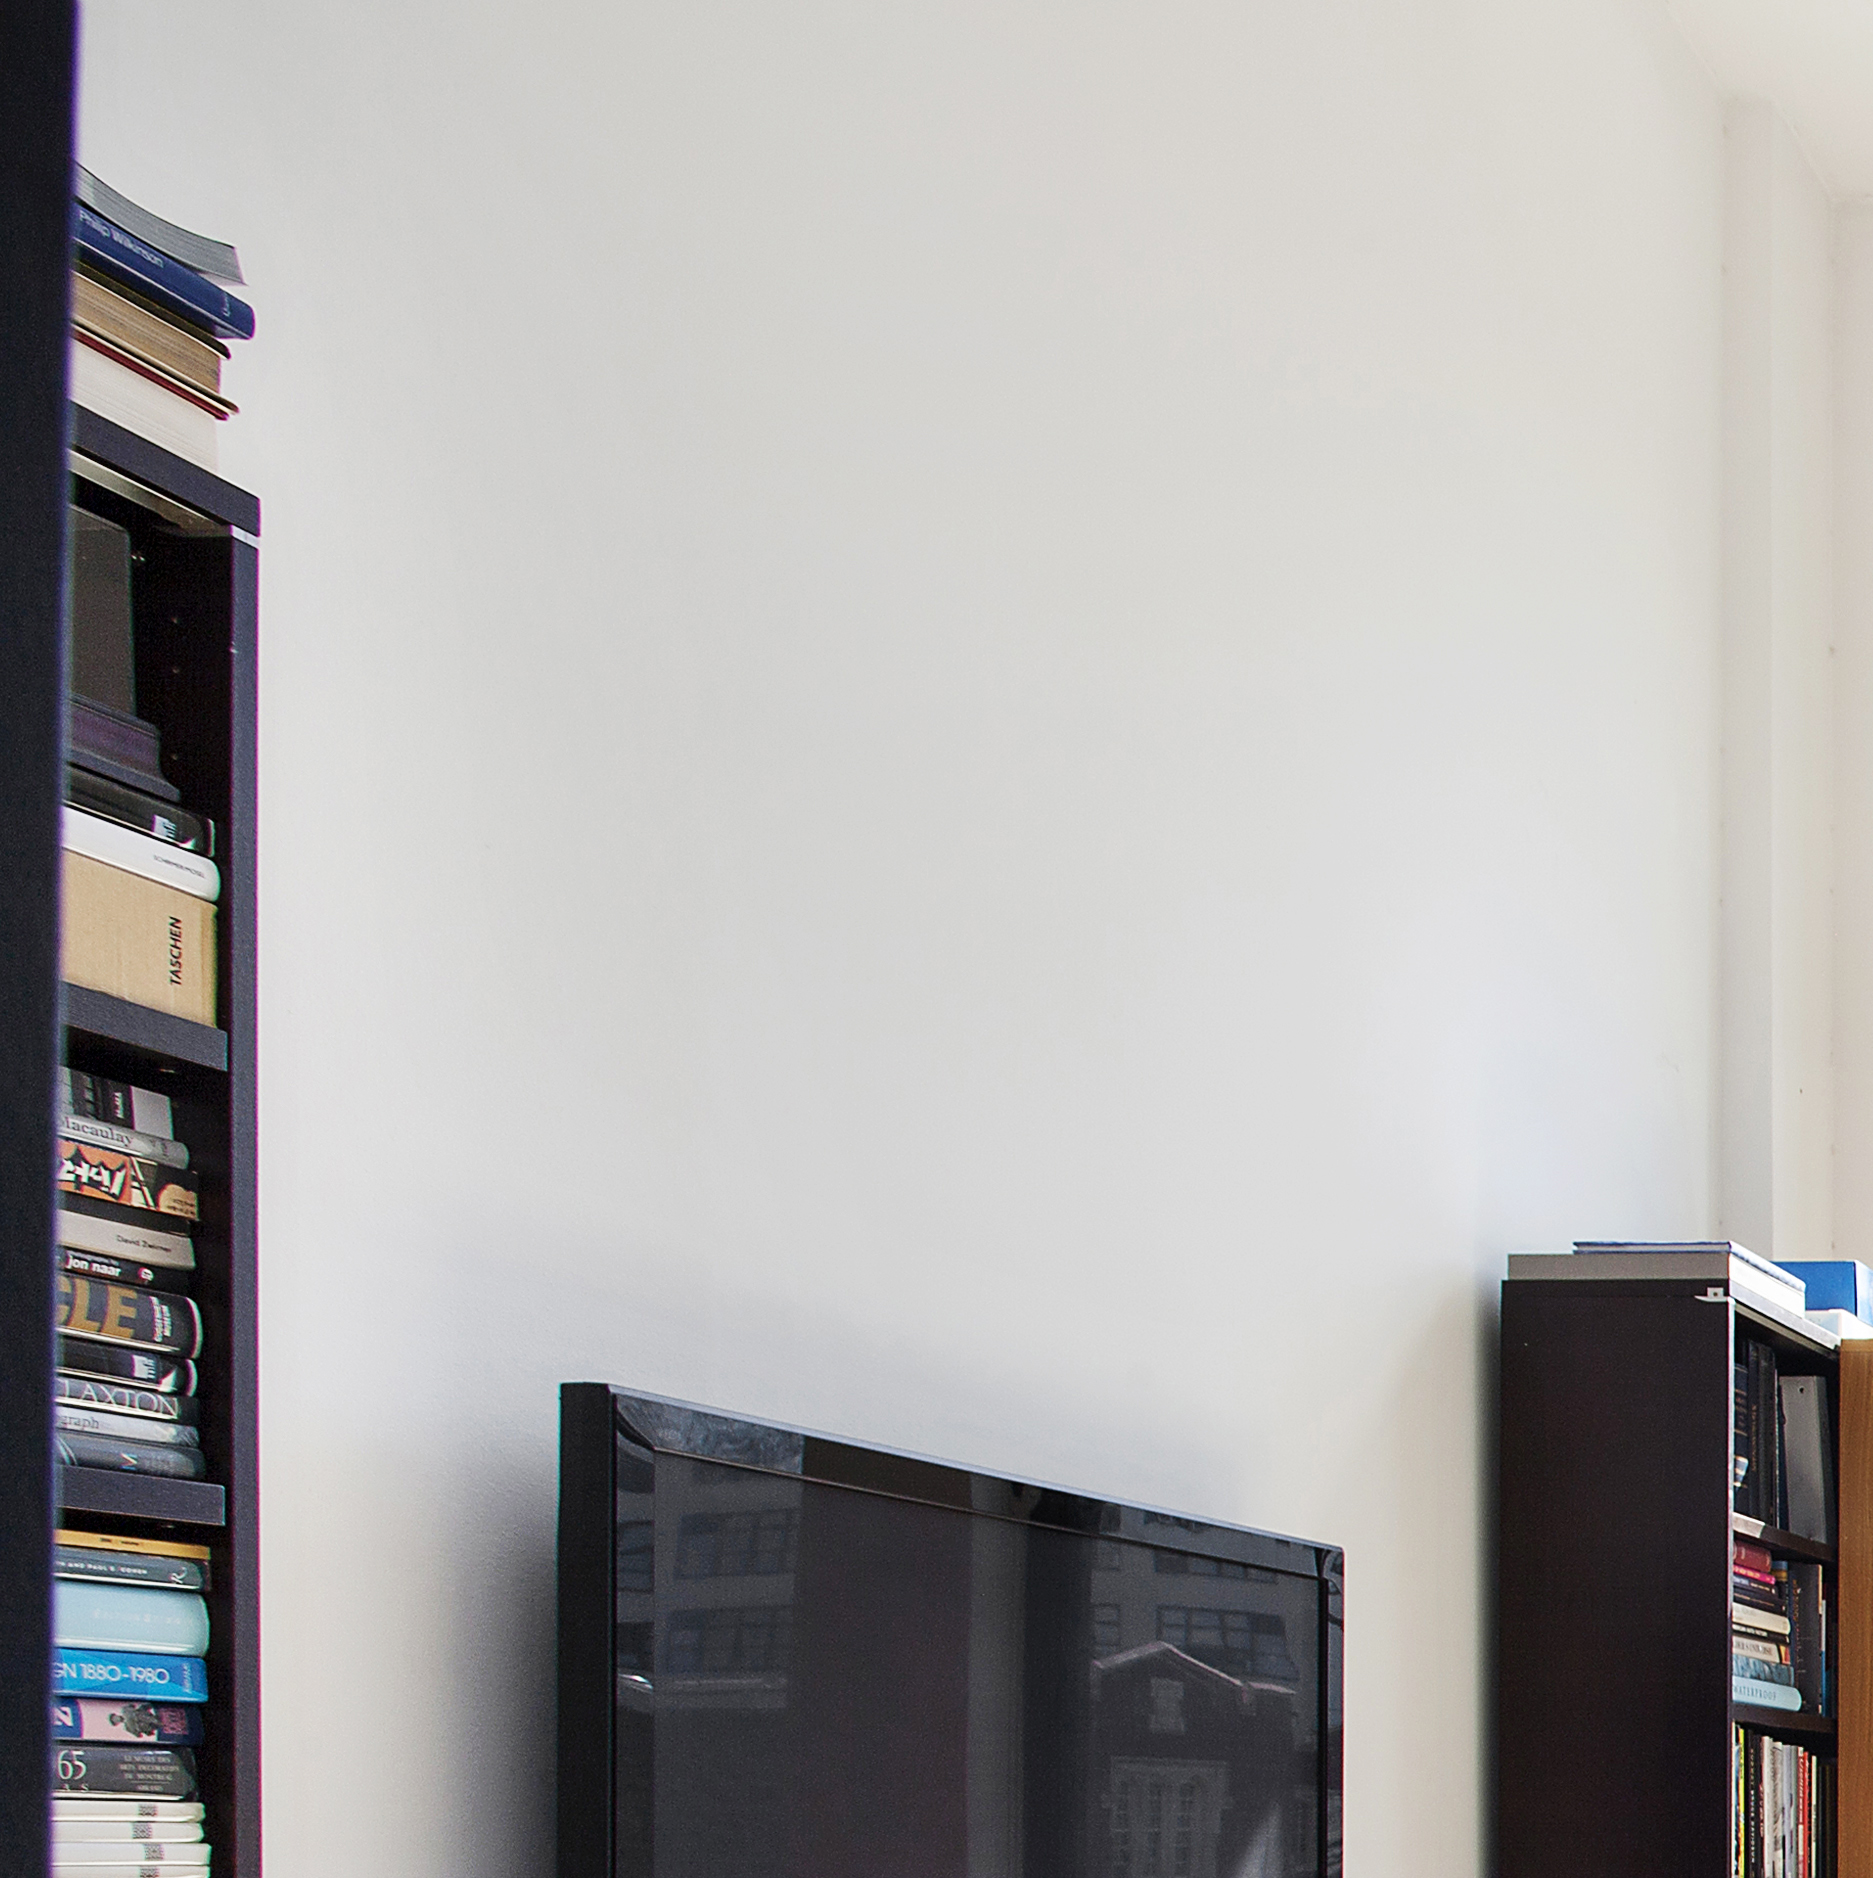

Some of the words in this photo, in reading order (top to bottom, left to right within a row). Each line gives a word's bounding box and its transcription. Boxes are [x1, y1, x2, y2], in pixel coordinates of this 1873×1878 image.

[80, 210, 111, 237] Philip
[111, 227, 164, 269] Wilkinson
[169, 915, 183, 986] TASCHEN
[117, 1235, 140, 1247] David
[66, 1254, 88, 1271] jon
[91, 1258, 121, 1277] naar
[58, 1379, 180, 1419] LAXTON
[87, 1563, 108, 1571] PAUL
[57, 1750, 87, 1780] 65
